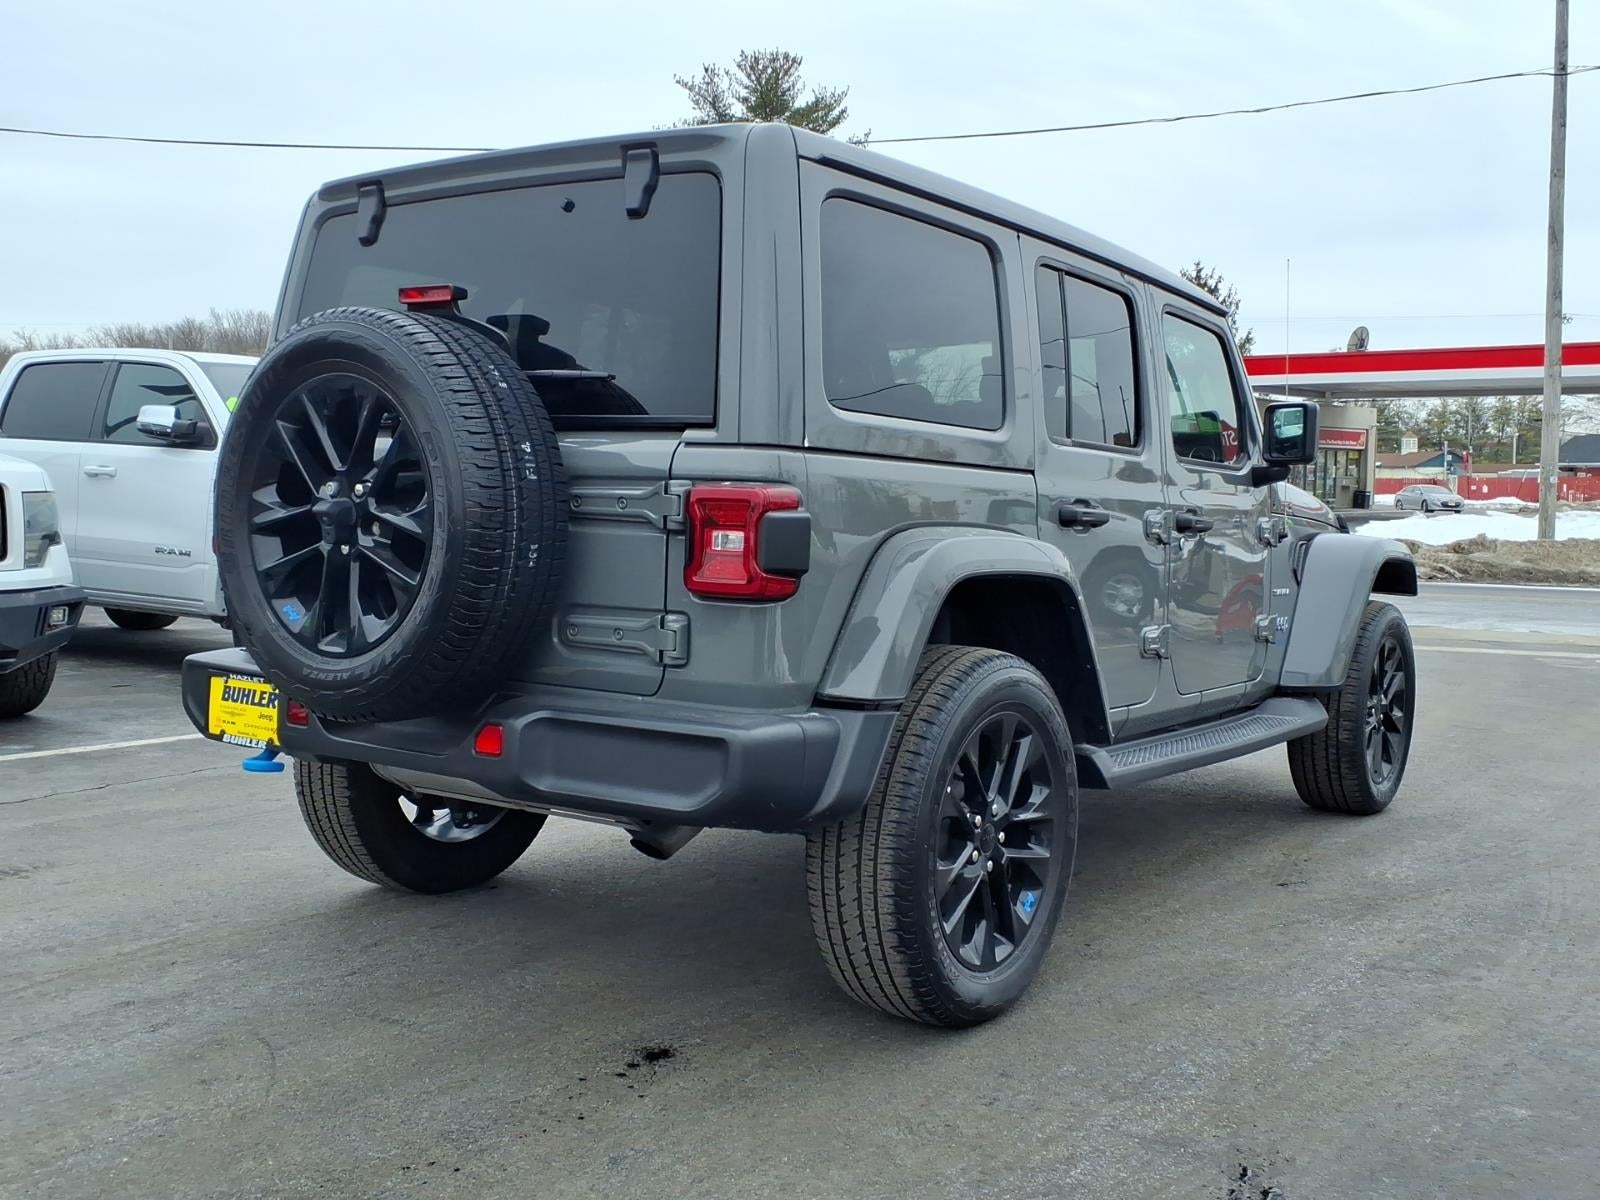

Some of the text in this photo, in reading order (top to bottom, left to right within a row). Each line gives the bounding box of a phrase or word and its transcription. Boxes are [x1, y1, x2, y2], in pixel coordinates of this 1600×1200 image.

[155, 546, 191, 557] RAM
[303, 662, 352, 681] ALENZA
[229, 673, 265, 684] HAZLET
[221, 684, 279, 709] BUHLER
[257, 711, 273, 722] Jeep
[222, 733, 267, 749] BUHLER
